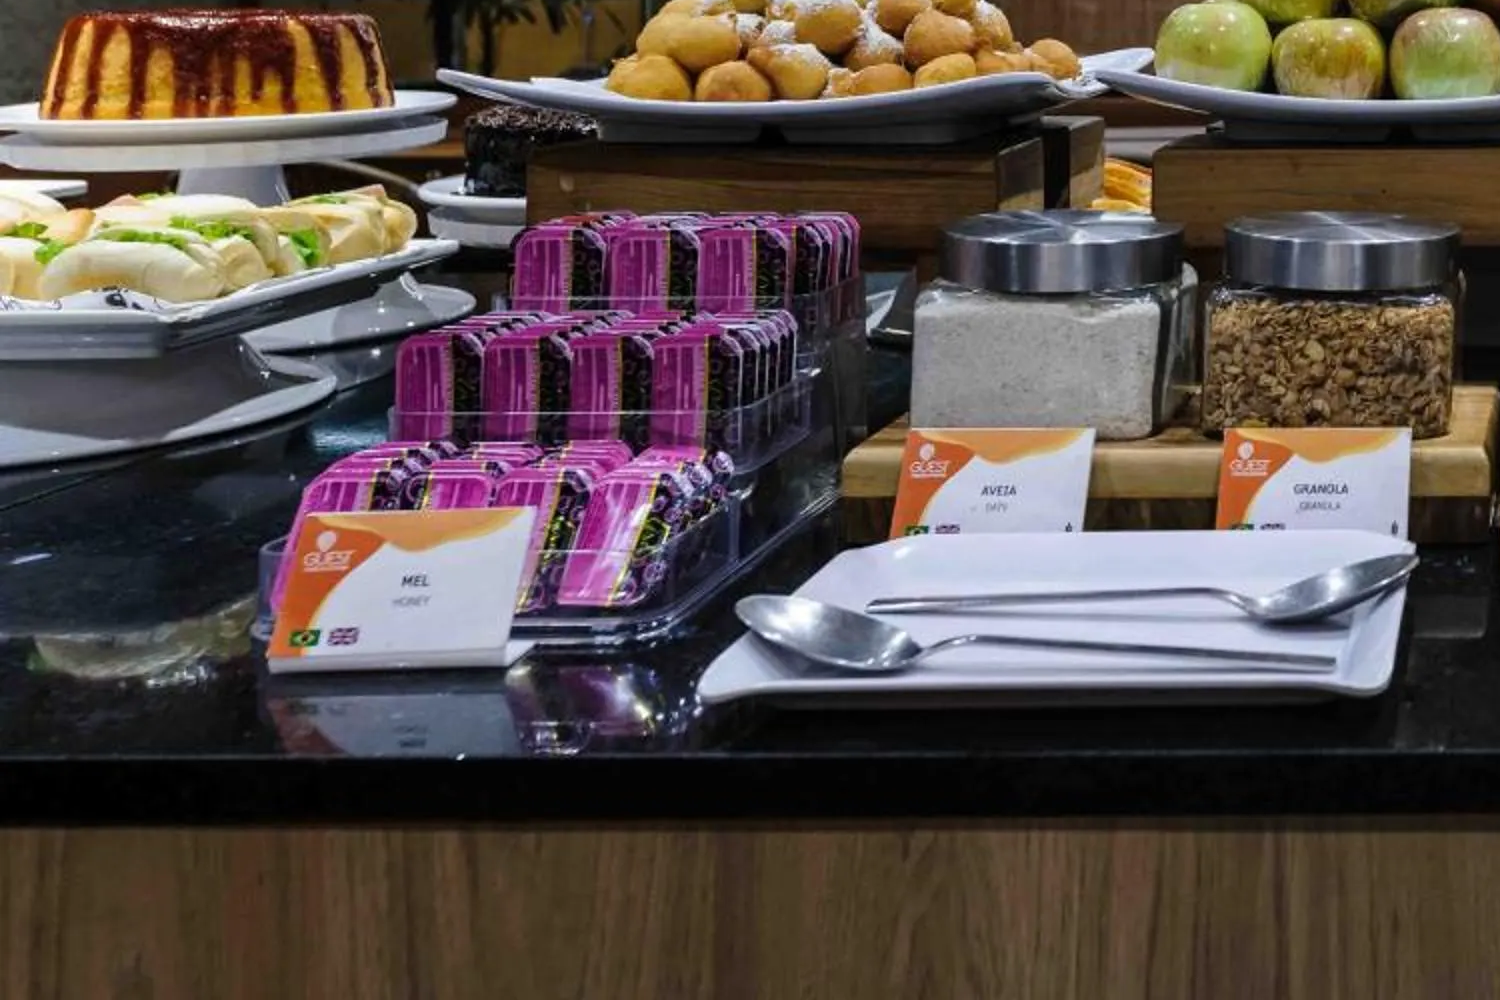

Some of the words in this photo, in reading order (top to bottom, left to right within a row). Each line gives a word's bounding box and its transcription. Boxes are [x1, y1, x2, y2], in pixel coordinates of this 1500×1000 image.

[981, 484, 1017, 497] AVEIA
[1293, 483, 1349, 495] GRANOLA
[401, 575, 429, 588] MEL
